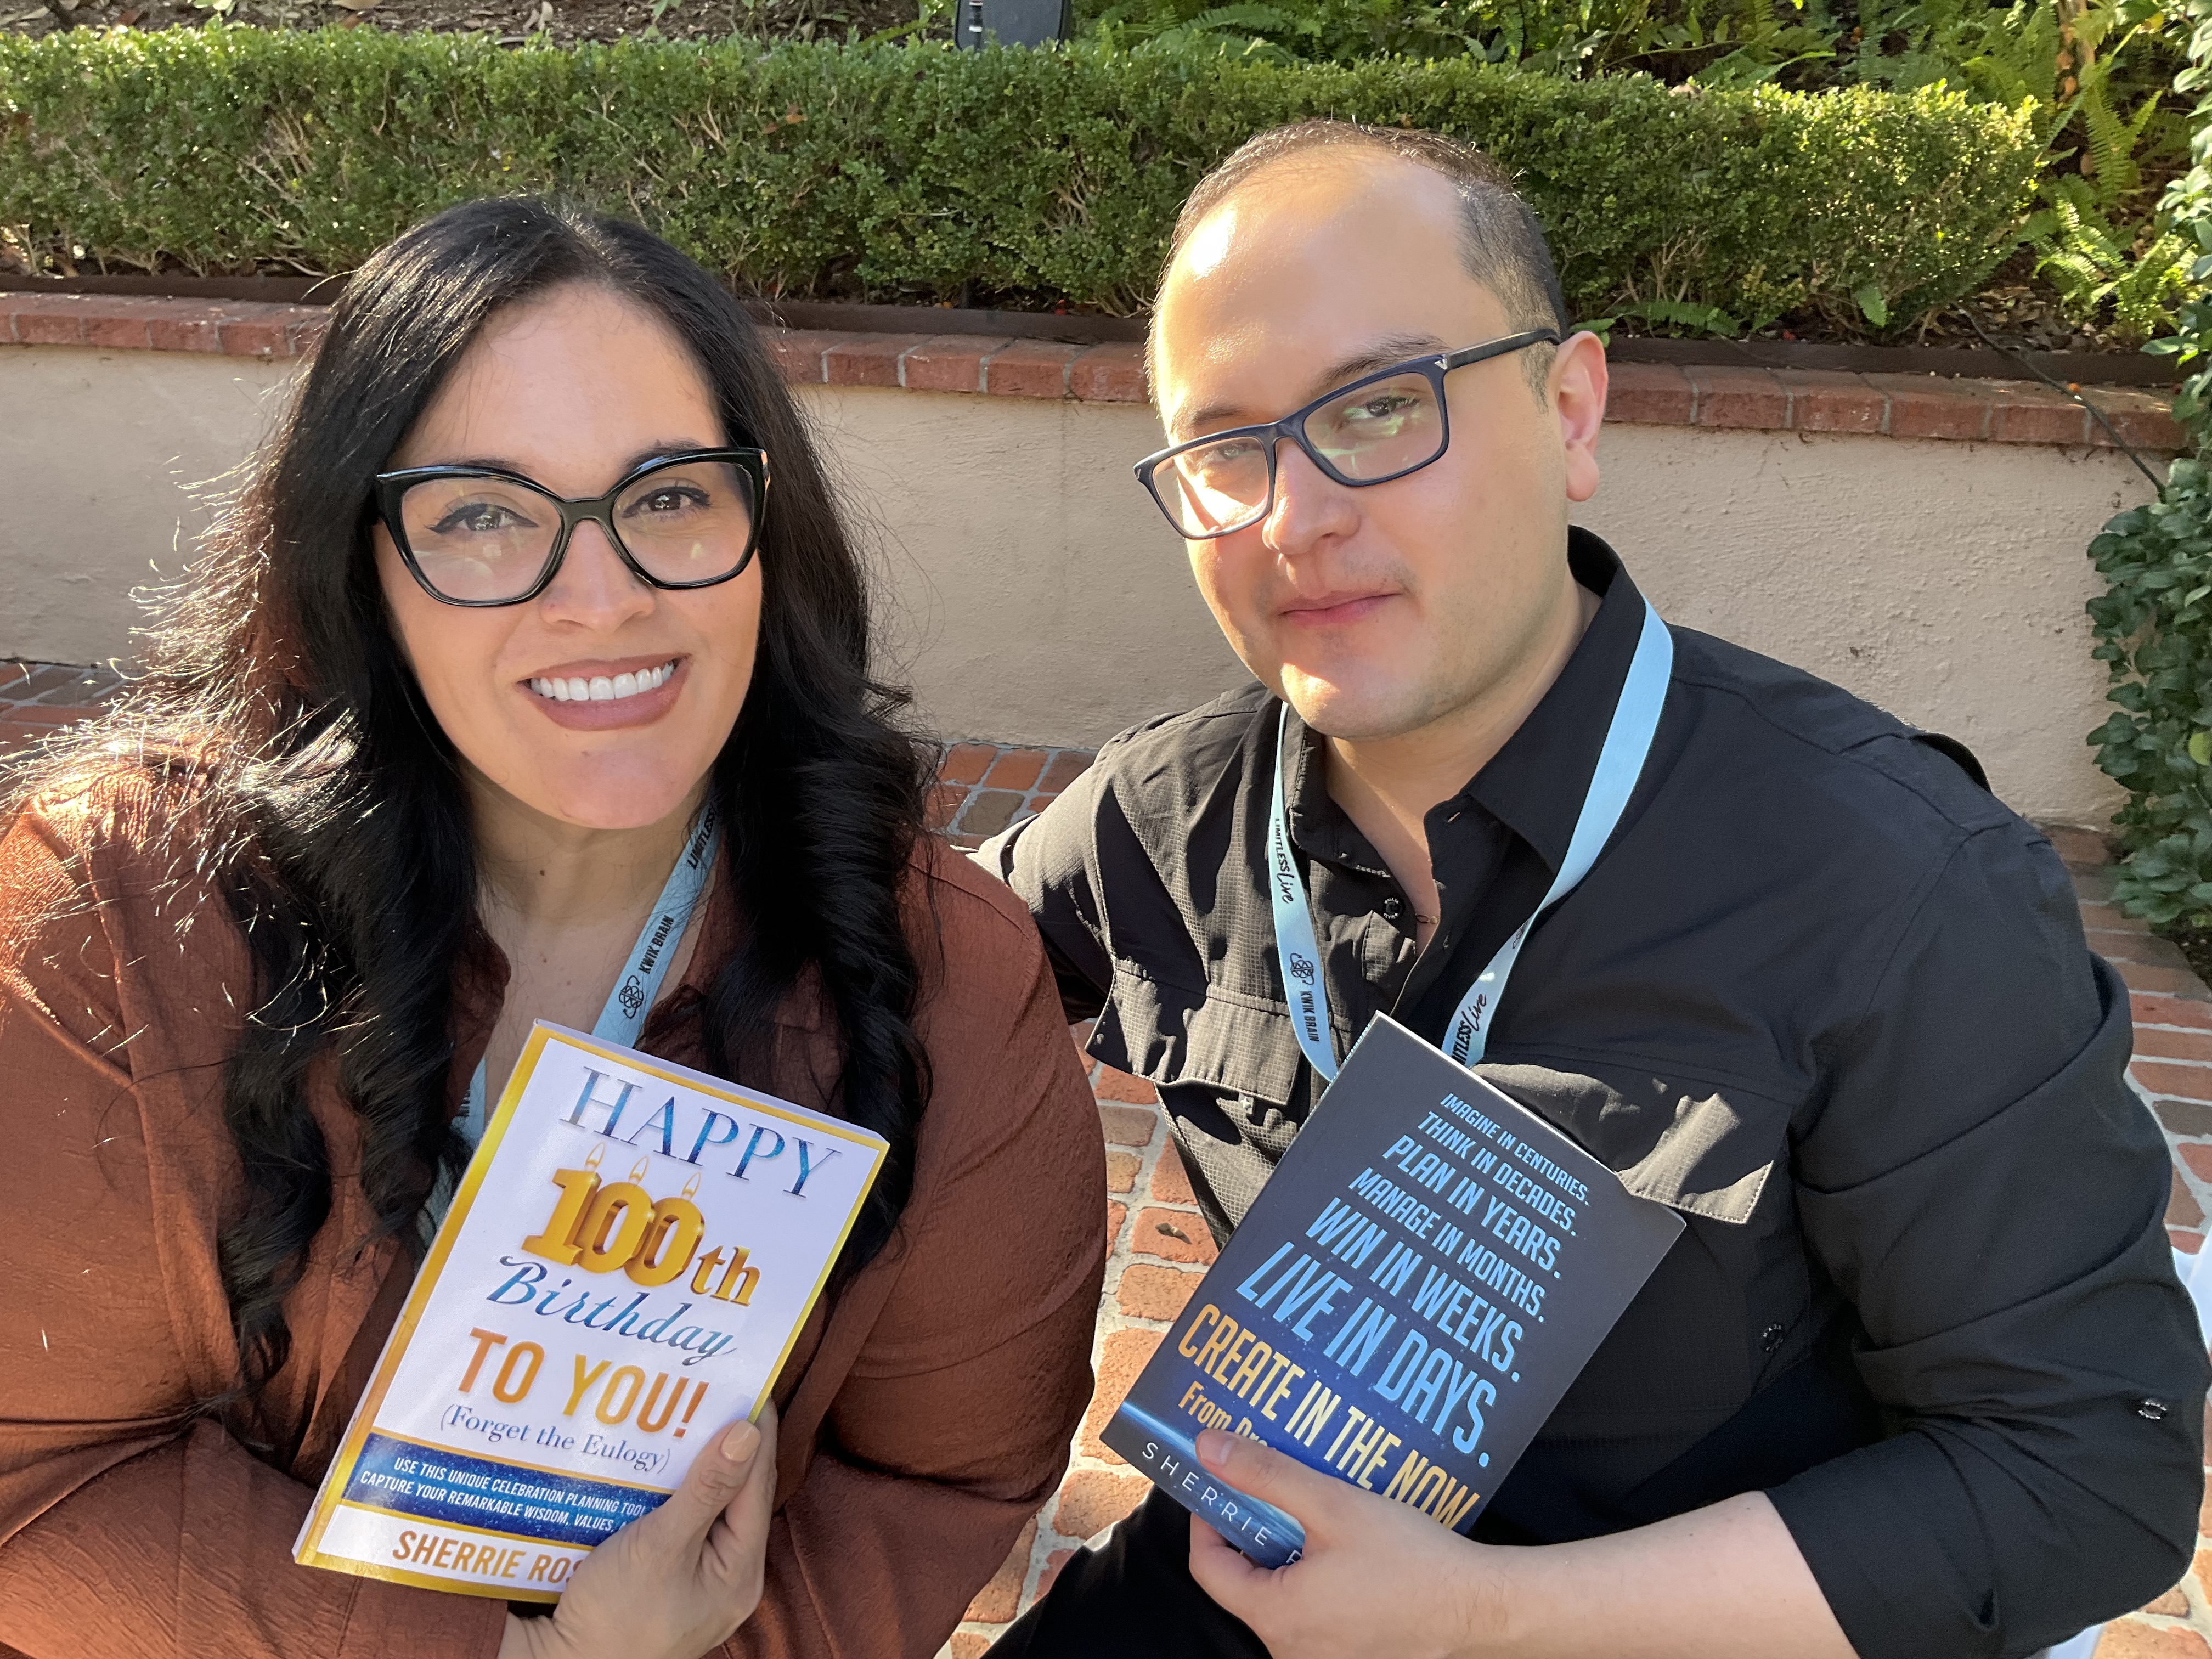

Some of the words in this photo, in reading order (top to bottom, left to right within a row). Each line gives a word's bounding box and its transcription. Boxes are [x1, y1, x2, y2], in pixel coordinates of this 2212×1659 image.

[1274, 817, 1290, 872] LIMITLESS
[1276, 872, 1295, 905] Live
[638, 946, 660, 974] KWIK
[652, 915, 674, 947] BRAIN
[1300, 991, 1315, 1013] KWIK
[1304, 1015, 1320, 1042] BRAIN
[1462, 994, 1487, 1031] Live
[560, 1066, 842, 1198] HAPPY
[1418, 1111, 1476, 1160] THINK
[1470, 1147, 1498, 1174] IN
[1493, 1162, 1577, 1237] DECADES.
[1440, 1093, 1501, 1139] IMAGINE
[1497, 1131, 1517, 1150] IN
[1514, 1142, 1589, 1205] CENTURIES.
[521, 1167, 760, 1306] 100th
[1348, 1167, 1441, 1240] MANAGE
[1432, 1221, 1464, 1256] IN
[1457, 1238, 1545, 1323] MONTHS.
[1383, 1135, 1457, 1194] PLAN
[1447, 1176, 1485, 1215] IN
[1481, 1195, 1561, 1279] YEARS.
[486, 1256, 737, 1366] Birthday
[1305, 1197, 1388, 1269] WIN
[1369, 1241, 1423, 1296] IN
[1411, 1264, 1523, 1383] WEEKS.
[458, 1327, 545, 1403] TO
[562, 1353, 709, 1438] YOU!
[1178, 1380, 1233, 1430] From
[1235, 1241, 1353, 1342] LIVE
[1323, 1296, 1397, 1376] IN
[1374, 1329, 1496, 1468] DAYS.
[441, 1404, 531, 1442] (Forget
[537, 1426, 575, 1450] the
[582, 1434, 670, 1473] Eulogy)
[1177, 1304, 1306, 1421] CREATE
[1284, 1380, 1341, 1447] IN
[1323, 1405, 1402, 1491] THE
[1383, 1449, 1481, 1530] NOW
[360, 1471, 415, 1494] CAPTURE
[416, 1483, 448, 1502] YOUR
[447, 1491, 523, 1517] REMARKABLE
[524, 1505, 569, 1526] WISDOM,
[574, 1514, 614, 1532] VALUES,
[394, 1457, 419, 1474] USE
[420, 1463, 447, 1480] THIS
[448, 1470, 492, 1490] UNIQUE
[491, 1479, 566, 1503] CELEBRATION
[565, 1492, 620, 1513] PLANNING
[1142, 1442, 1272, 1546] SHERRIE
[392, 1530, 526, 1578] SHERRIE
